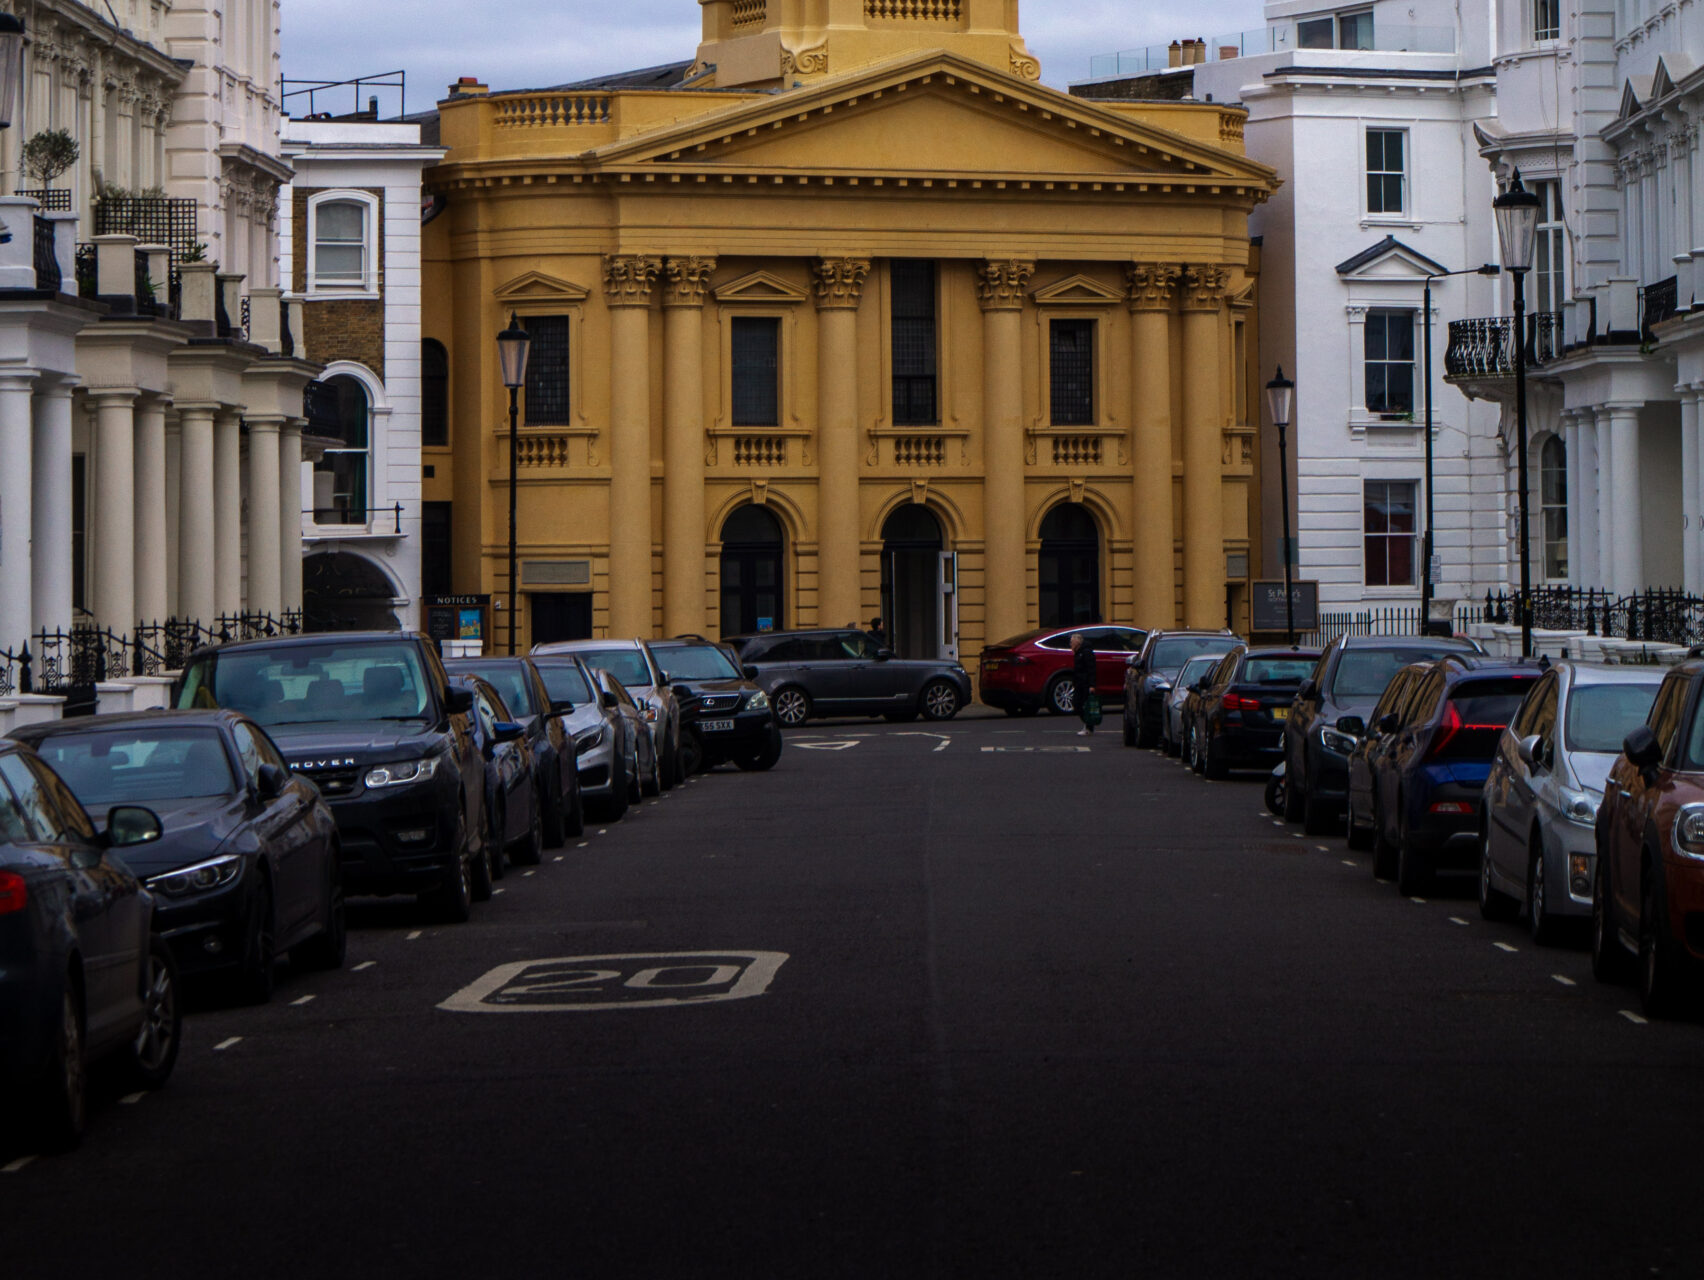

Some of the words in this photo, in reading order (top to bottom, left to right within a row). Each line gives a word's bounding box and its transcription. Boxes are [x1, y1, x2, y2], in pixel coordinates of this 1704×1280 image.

[436, 596, 478, 605] NOTICES
[290, 757, 355, 769] ROVER
[500, 964, 741, 995] 20
